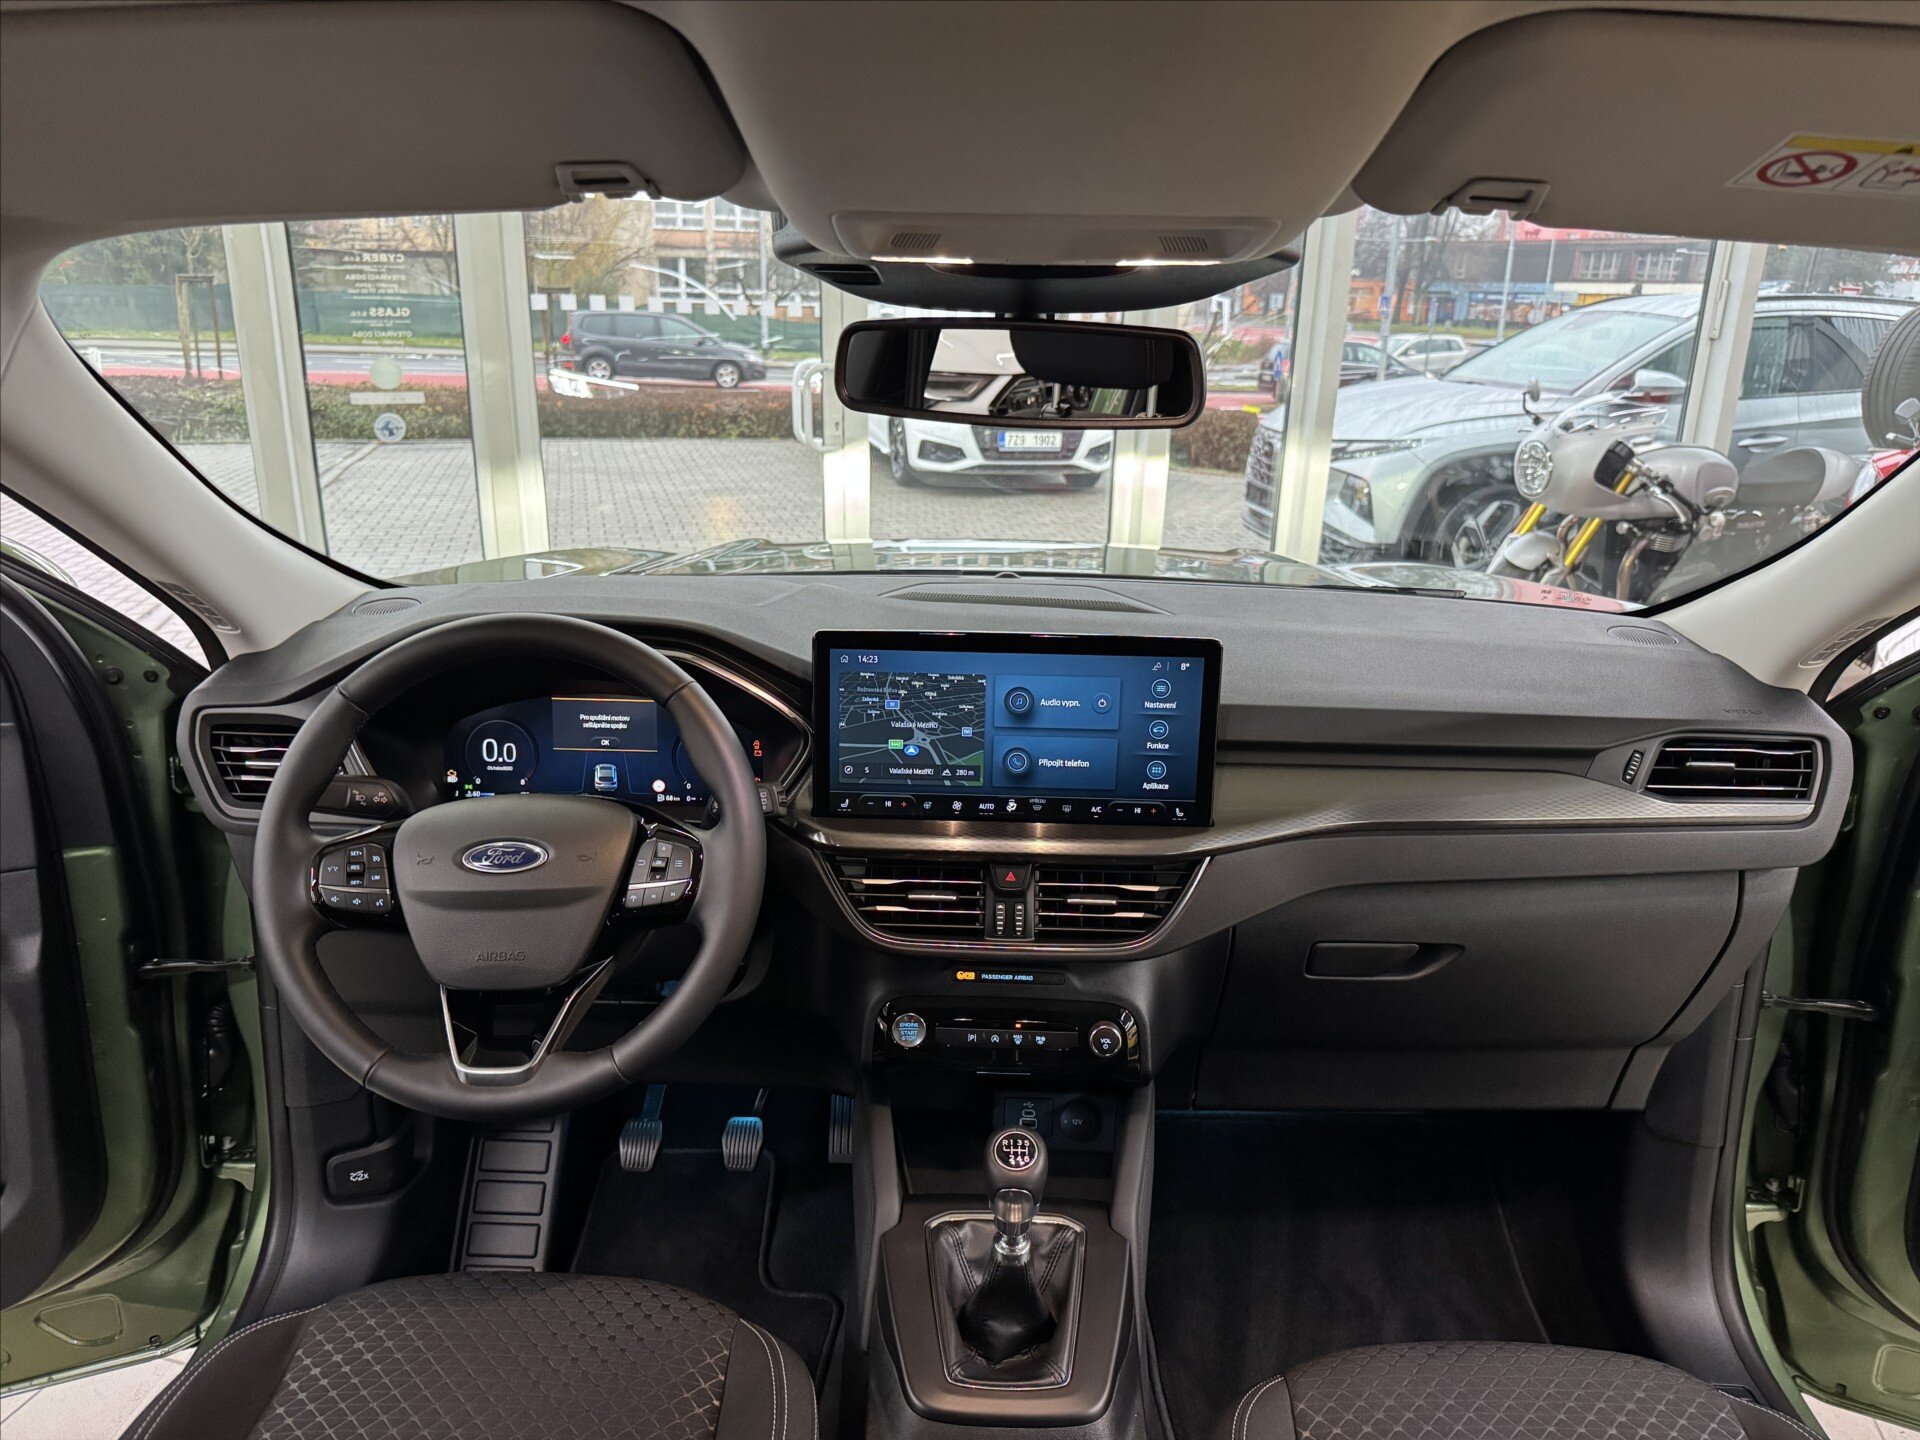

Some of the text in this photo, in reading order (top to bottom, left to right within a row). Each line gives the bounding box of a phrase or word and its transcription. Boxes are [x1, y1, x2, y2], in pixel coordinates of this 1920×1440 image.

[1033, 435, 1057, 446] 1902
[858, 654, 878, 663] 14:23
[1040, 698, 1060, 706] Audio
[482, 738, 517, 762] 0.0
[1146, 742, 1170, 750] Funkce
[1038, 758, 1090, 768] Připojit telefon
[1142, 782, 1169, 790] Aplikace
[482, 848, 526, 865] Ford
[476, 952, 526, 962] AIRBAG
